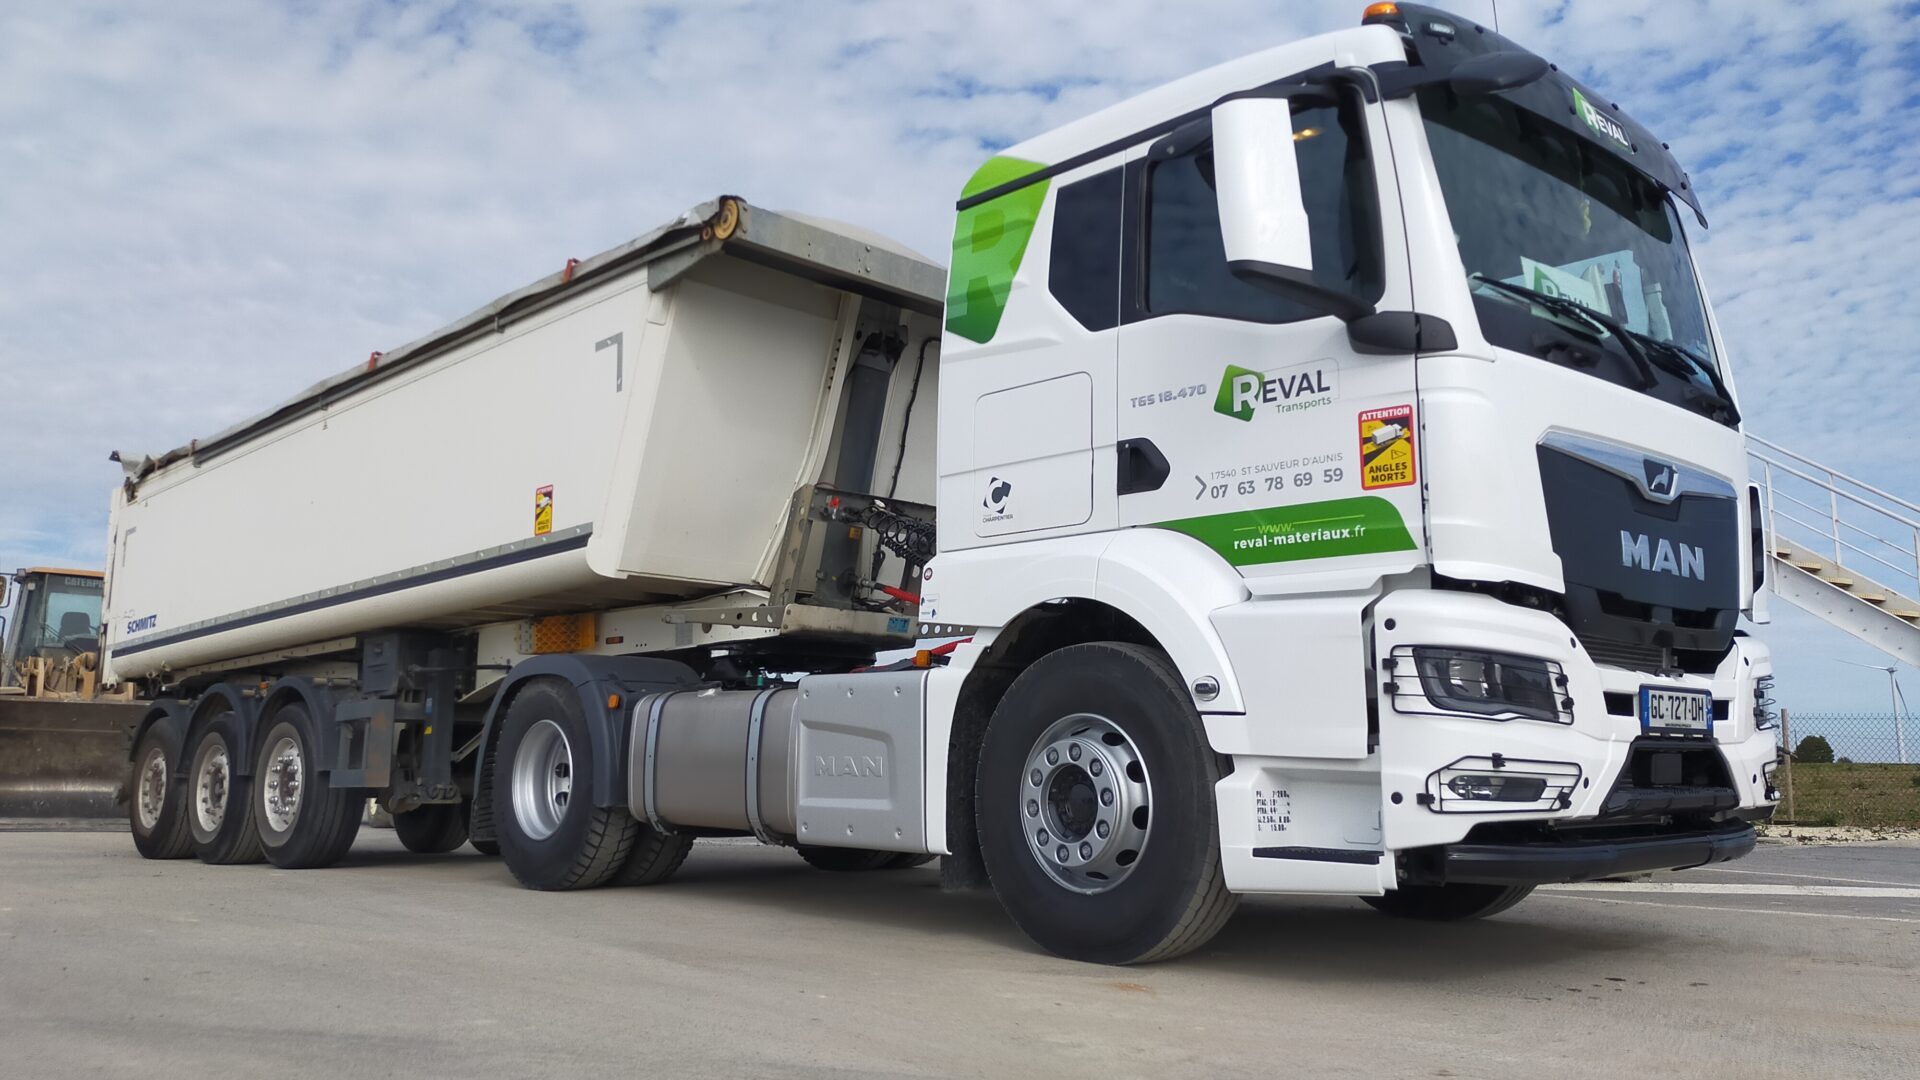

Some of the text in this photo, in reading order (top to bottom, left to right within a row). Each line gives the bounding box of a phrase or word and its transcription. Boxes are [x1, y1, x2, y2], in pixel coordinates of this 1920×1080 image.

[1580, 99, 1629, 146] REVAL
[1130, 383, 1208, 408] TGS 18.470
[1232, 370, 1331, 413] REVAL
[1275, 396, 1332, 415] Transports
[1361, 406, 1410, 421] ATTENTION
[1211, 453, 1343, 480] 17540 ST SAUVEUR D'AUNIS
[1368, 461, 1408, 474] ANGLES
[1371, 471, 1406, 483] MORTS
[1211, 467, 1343, 499] 07 63 78 69 59
[1234, 525, 1366, 550] reval-materiaux.fr
[1258, 522, 1295, 534] www.
[1620, 529, 1705, 581] MAN
[127, 614, 158, 635] SCHMITZ
[815, 754, 883, 777] MAN
